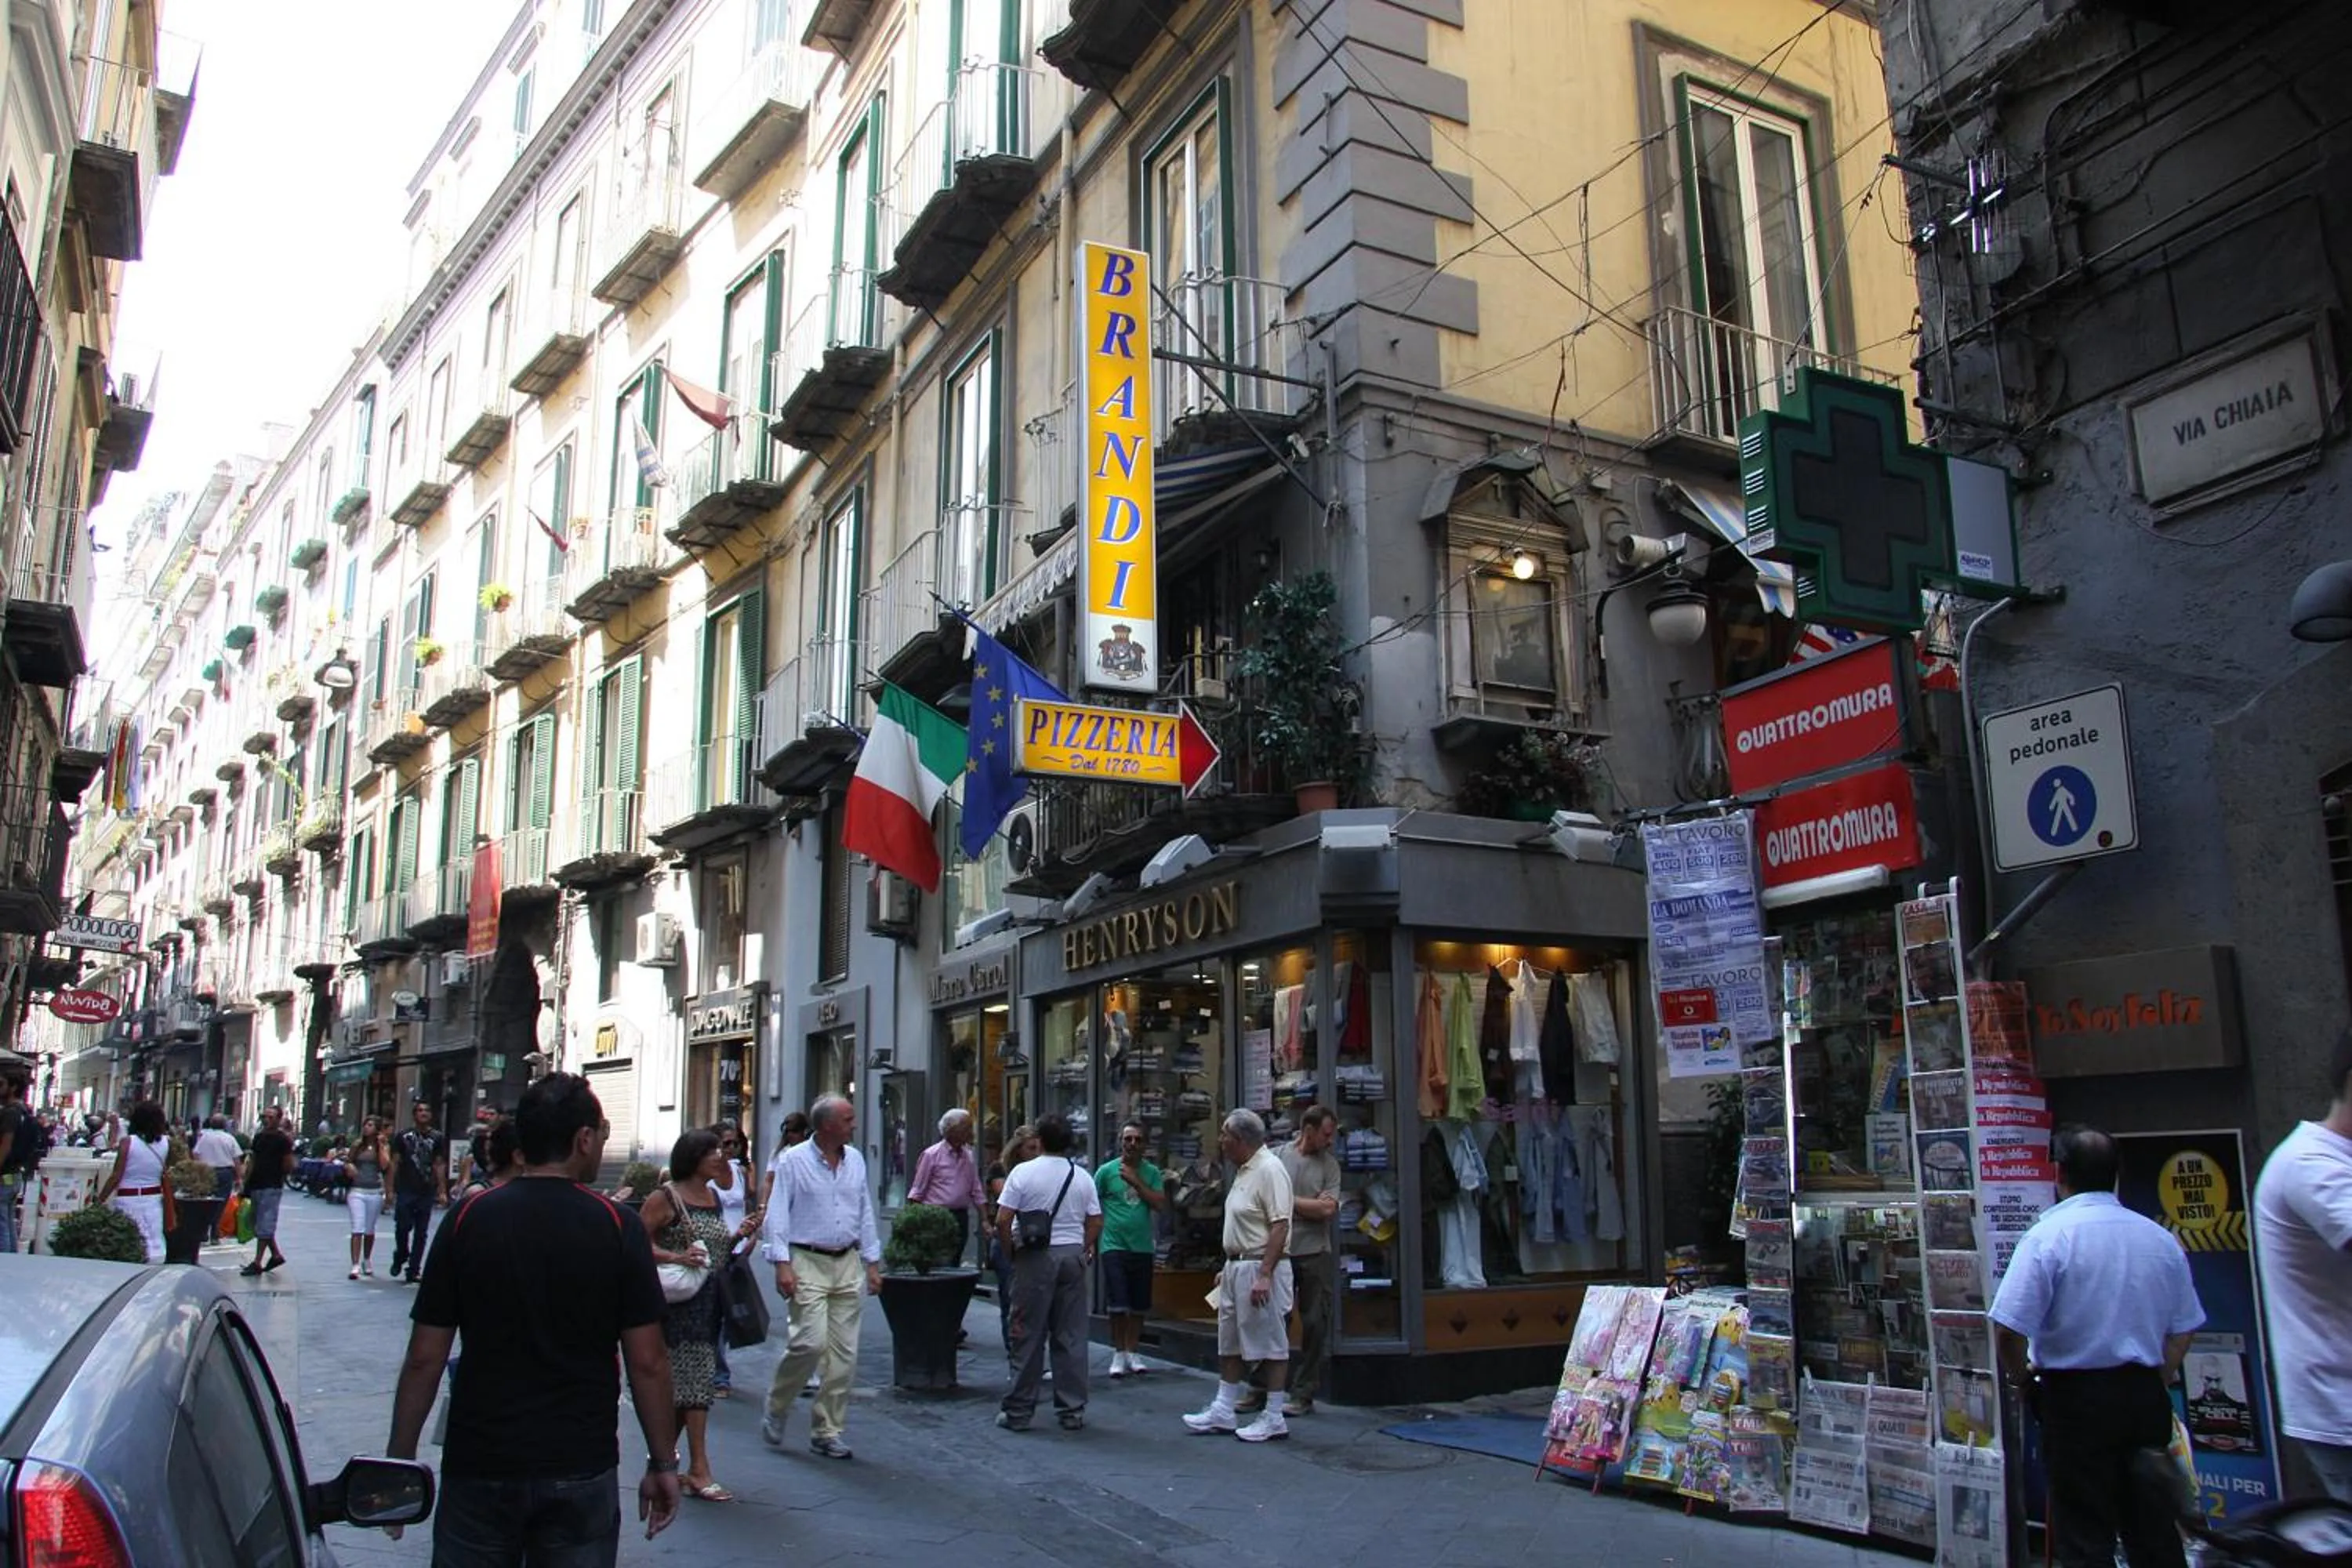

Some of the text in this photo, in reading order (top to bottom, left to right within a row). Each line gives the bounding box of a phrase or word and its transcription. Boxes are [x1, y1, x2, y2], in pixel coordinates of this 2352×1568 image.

[2172, 381, 2294, 446] VIA CHIAIA
[1095, 251, 1143, 611] BRANDI
[1736, 682, 1894, 754] QUATTROMURA
[2029, 708, 2073, 732] area
[1026, 708, 1176, 758] PIZZERIA
[2009, 726, 2100, 765] pedonale
[1069, 753, 1141, 775] Dal 1780
[1766, 801, 1899, 868] QUATTROMURA
[60, 915, 139, 939] PODOLOGO
[1062, 880, 1240, 972] HENRYSON
[1991, 1165, 2040, 1178] Repubblica
[2177, 1159, 2203, 1174] A UN
[2171, 1174, 2213, 1190] PREZZO
[2183, 1189, 2205, 1204] MAI
[2176, 1203, 2216, 1220] VISTO!
[2232, 1476, 2267, 1497] PER
[2207, 1492, 2226, 1519] 2
